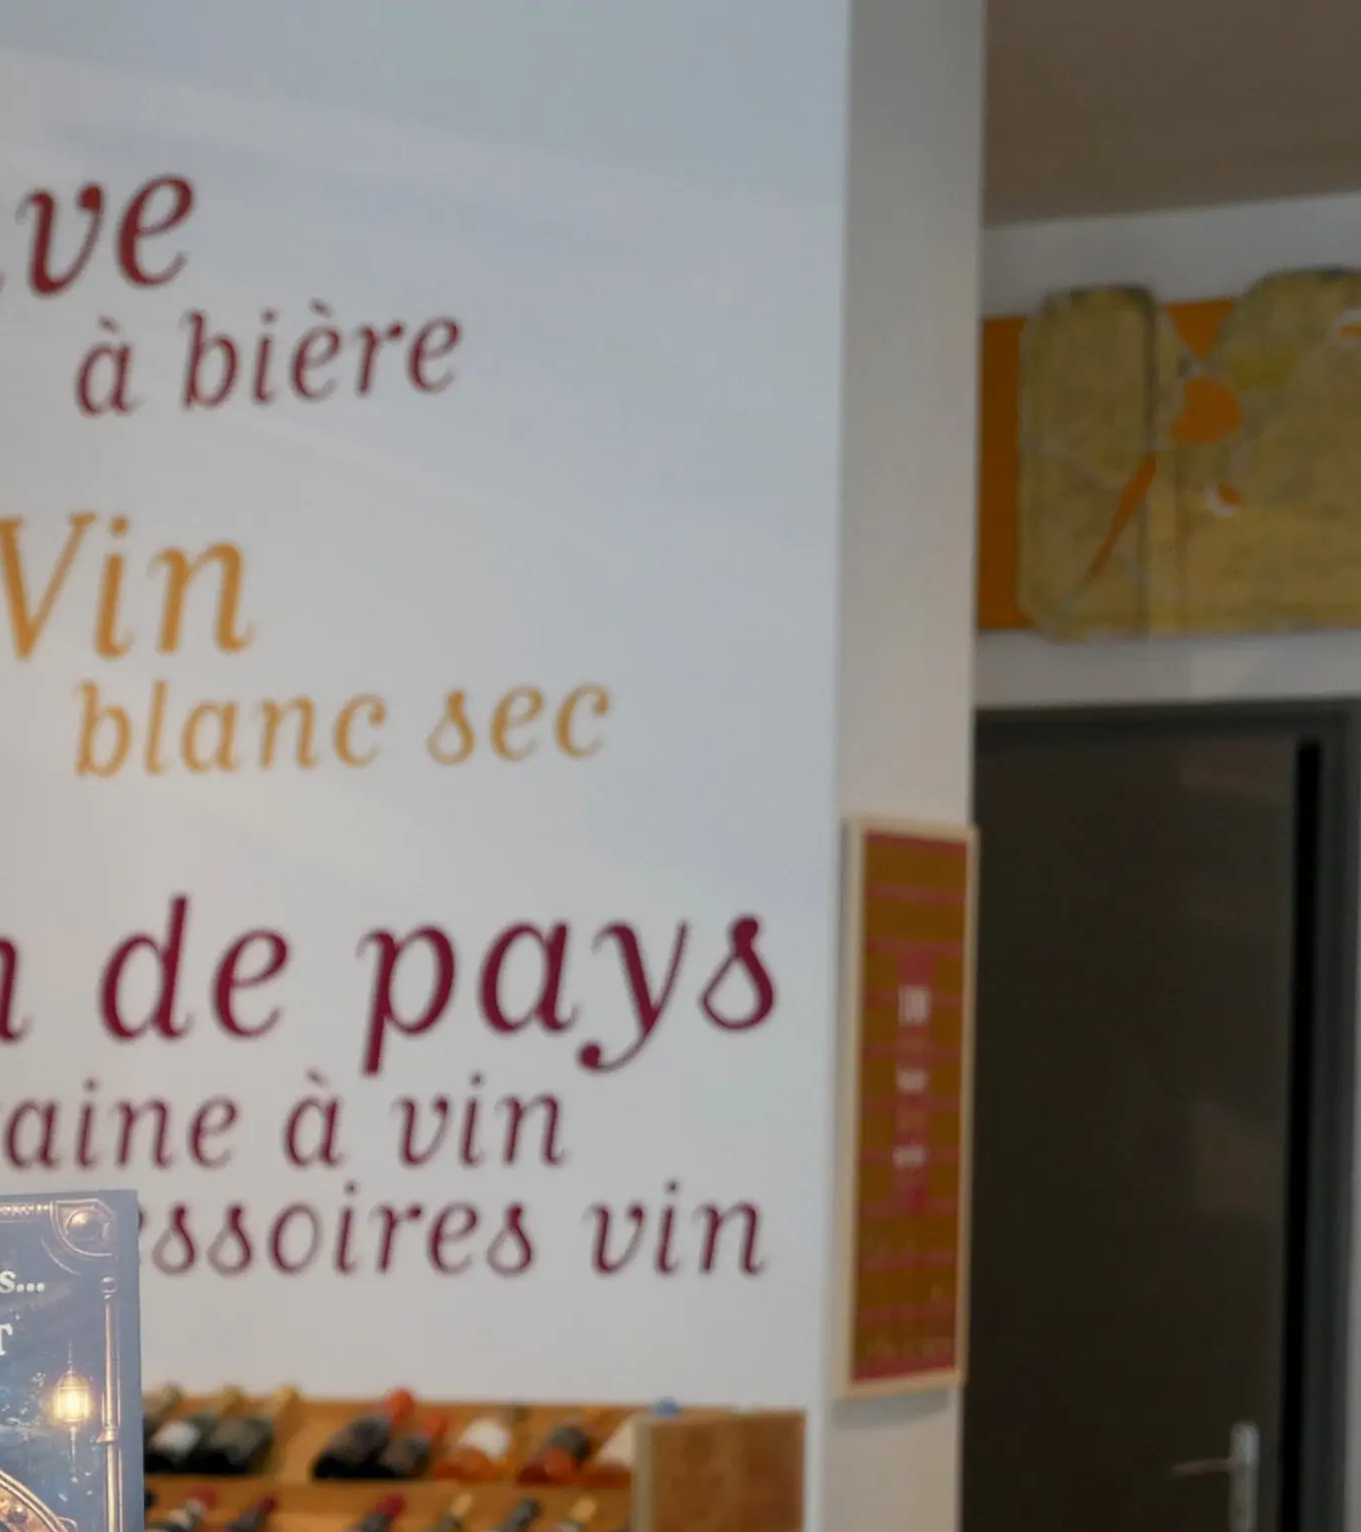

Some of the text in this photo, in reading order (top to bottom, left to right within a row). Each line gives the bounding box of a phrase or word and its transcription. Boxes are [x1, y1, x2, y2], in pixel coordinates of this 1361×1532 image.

[76, 300, 461, 417] à bière
[74, 678, 611, 779] blanc sec
[100, 894, 292, 1042] de
[360, 914, 779, 1077] pays
[284, 1069, 345, 1168] à
[399, 1075, 571, 1168] vin
[138, 1180, 766, 1277] ssoires vin
